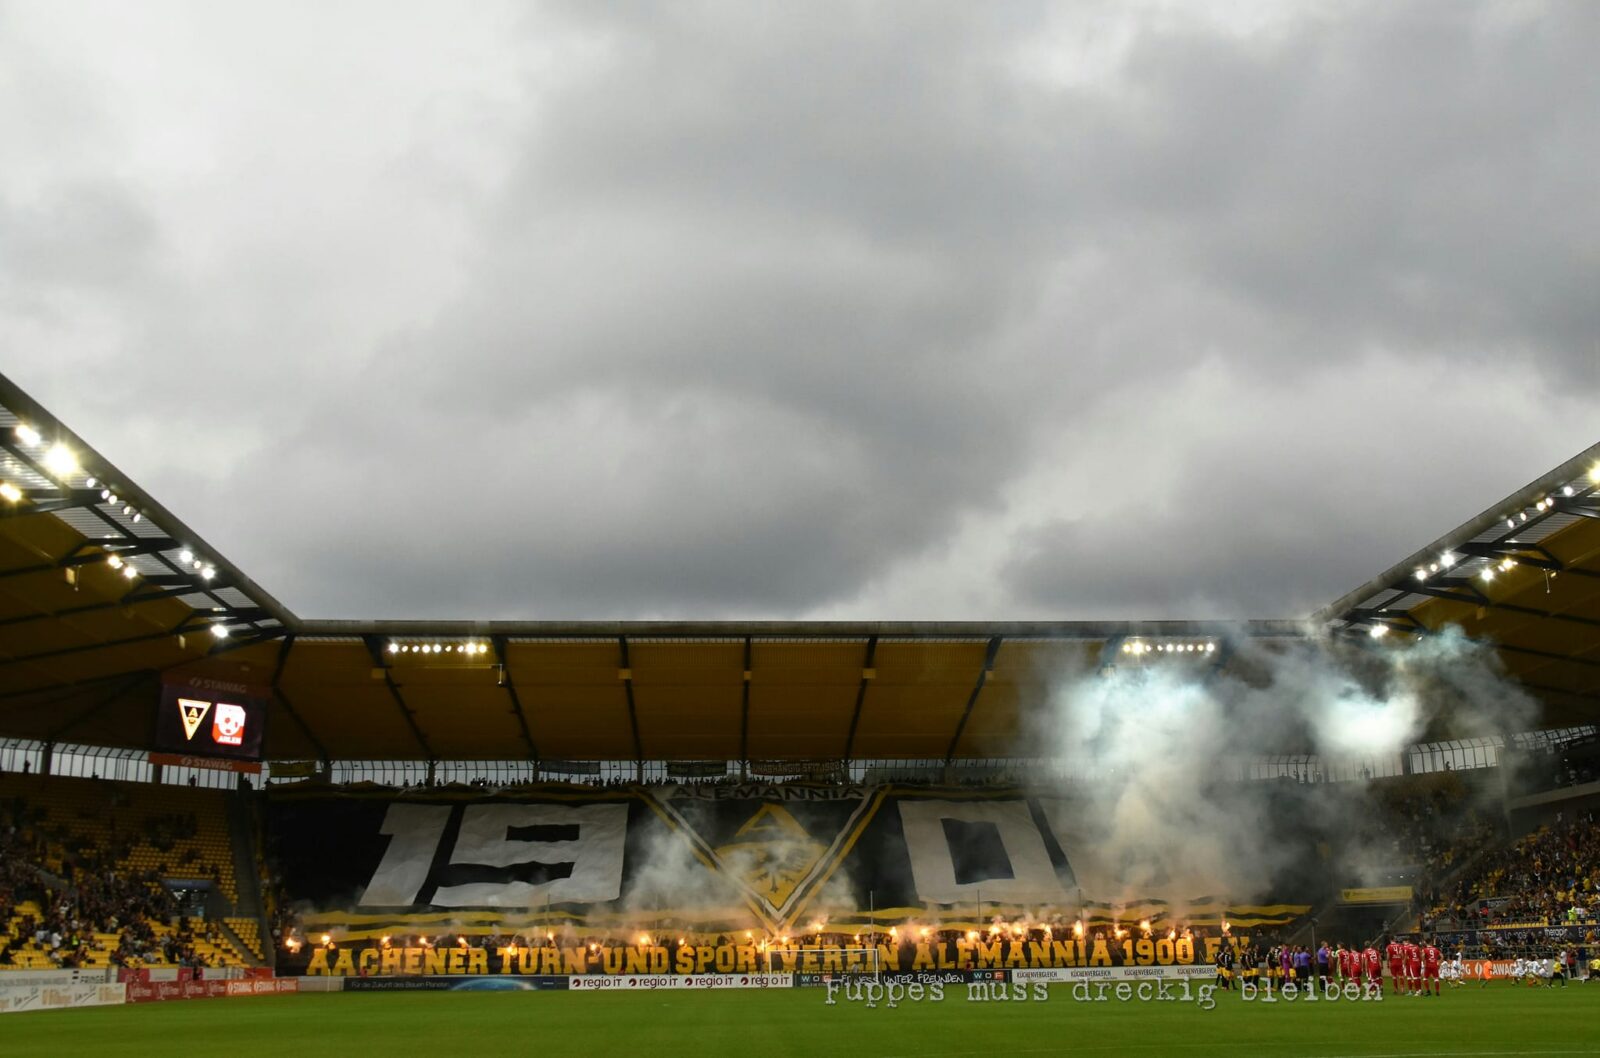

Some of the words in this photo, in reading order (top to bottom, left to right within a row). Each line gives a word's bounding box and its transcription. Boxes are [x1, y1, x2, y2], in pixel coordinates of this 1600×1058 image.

[203, 678, 248, 694] STAWAG
[193, 759, 233, 770] STAWAG
[672, 785, 865, 800] ALEMANNIA
[306, 948, 489, 976] AACHENER
[914, 938, 1112, 970] ALEMANNIA
[1122, 938, 1195, 967] 1900
[1017, 970, 1058, 979] KÜCHENVERGLEICH
[1071, 969, 1112, 978] KÜCHENVERGLEICH
[1124, 968, 1164, 976] KÜCHENVERGLEICH
[583, 975, 612, 988] regio
[639, 975, 668, 988] regio
[695, 974, 724, 987] regio
[884, 974, 914, 985] UNTER
[918, 973, 964, 984] FREUNDEN
